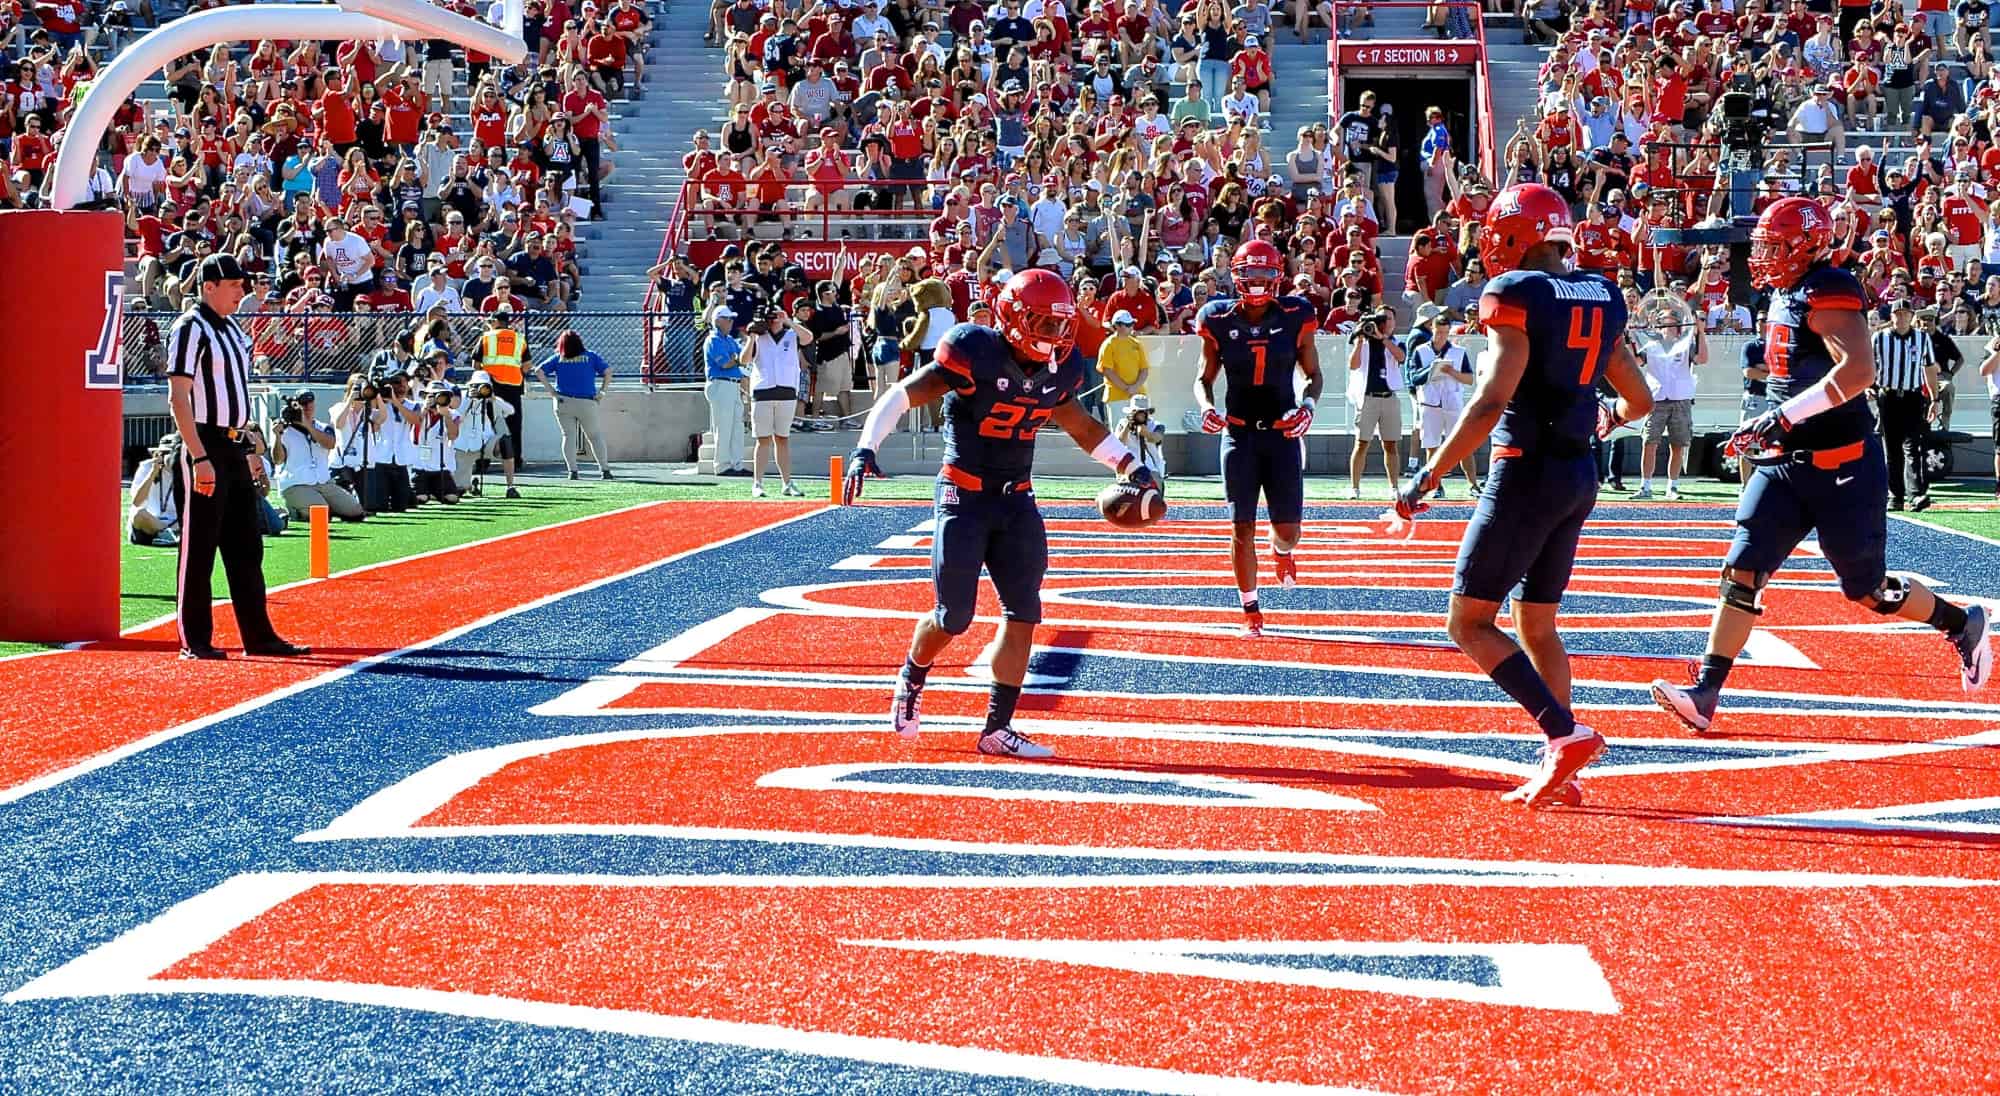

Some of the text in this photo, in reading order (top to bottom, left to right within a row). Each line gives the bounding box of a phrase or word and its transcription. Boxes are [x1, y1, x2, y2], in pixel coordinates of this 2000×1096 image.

[1370, 49, 1445, 63] 17 SECTION 18
[550, 141, 570, 163] A
[1798, 207, 1822, 231] A
[1567, 305, 1604, 385] 4
[1250, 346, 1267, 386] 1
[978, 402, 1055, 441] 23
